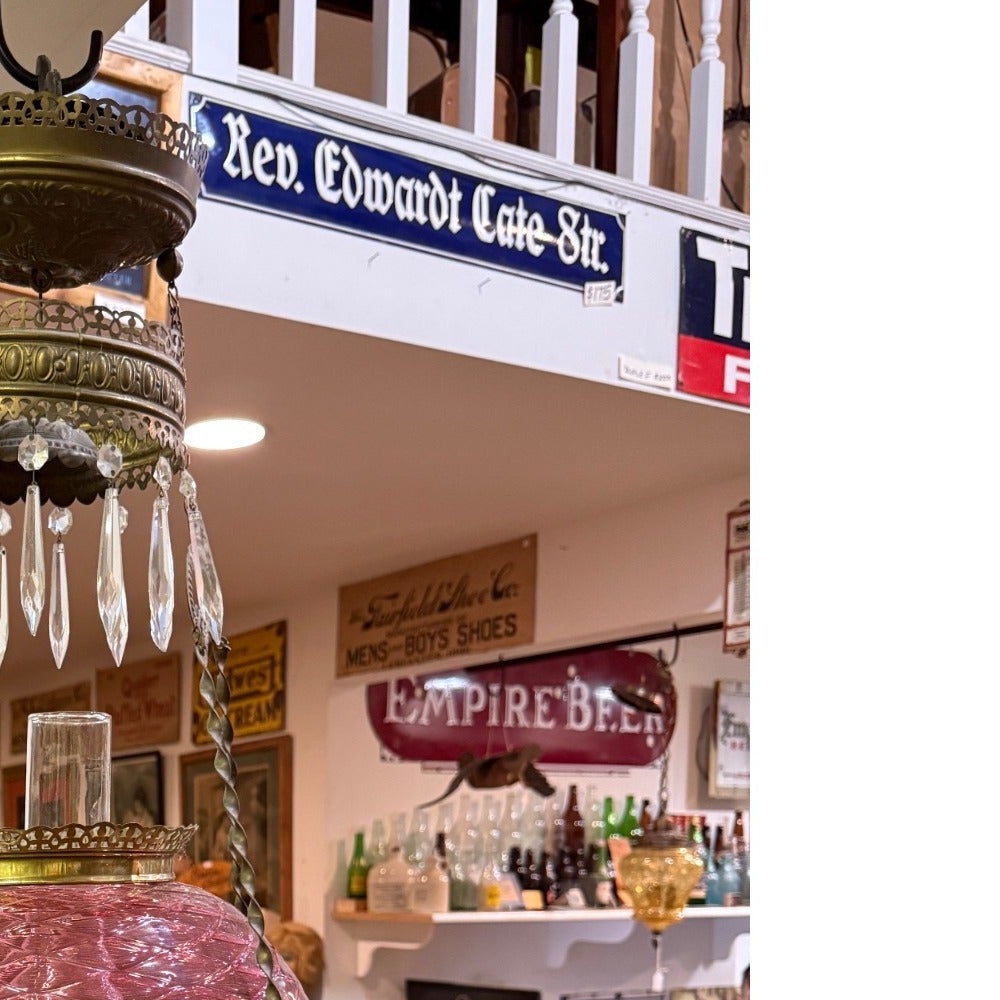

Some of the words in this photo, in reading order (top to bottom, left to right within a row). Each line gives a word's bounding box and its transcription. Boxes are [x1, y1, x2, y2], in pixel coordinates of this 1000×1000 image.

[222, 111, 304, 194] Rev.
[557, 205, 609, 274] Str.
[345, 641, 388, 668] MENS
[404, 627, 449, 656] BOYS
[456, 613, 518, 647] SHOES
